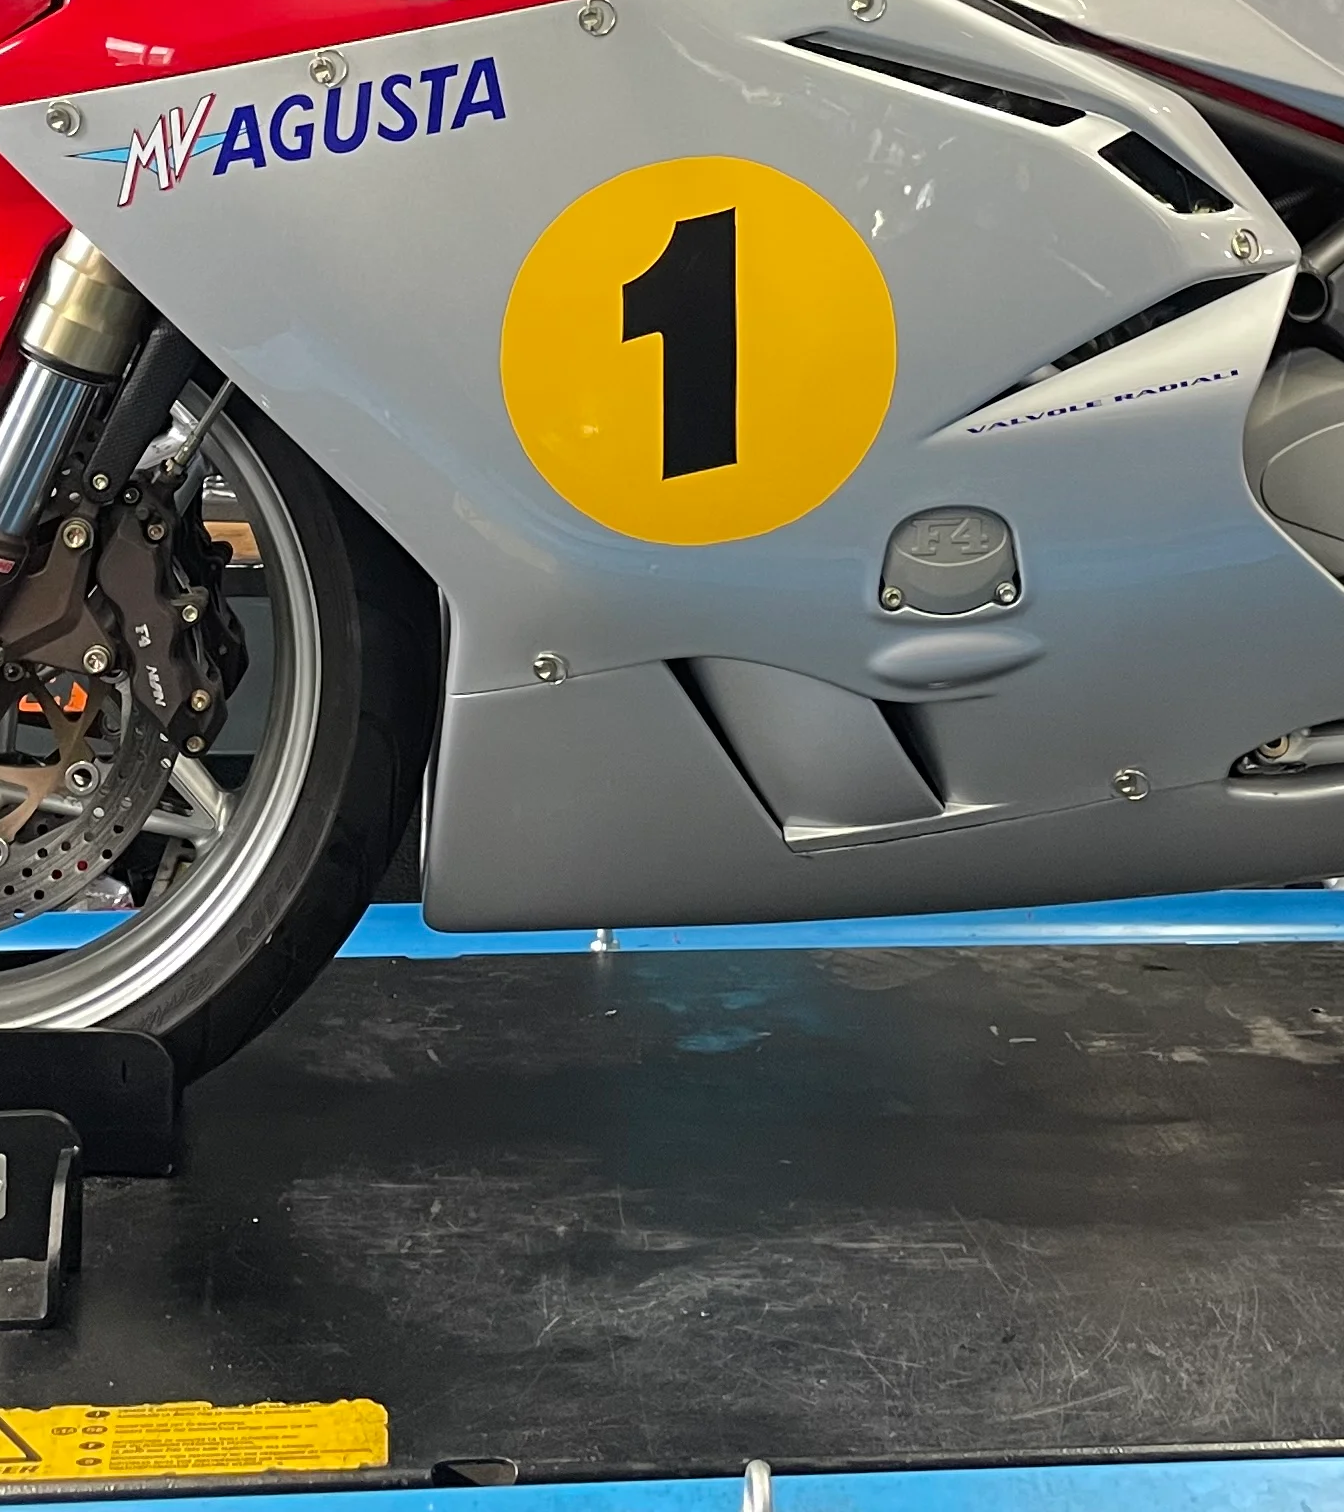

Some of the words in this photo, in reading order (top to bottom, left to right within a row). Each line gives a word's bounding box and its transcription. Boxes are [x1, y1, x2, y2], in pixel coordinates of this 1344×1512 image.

[117, 92, 216, 208] MV
[212, 56, 506, 176] AGUSTA
[621, 206, 738, 481] 1
[966, 399, 1102, 434] VALVOLE
[1114, 369, 1239, 402] RADIALI
[910, 516, 990, 556] F4
